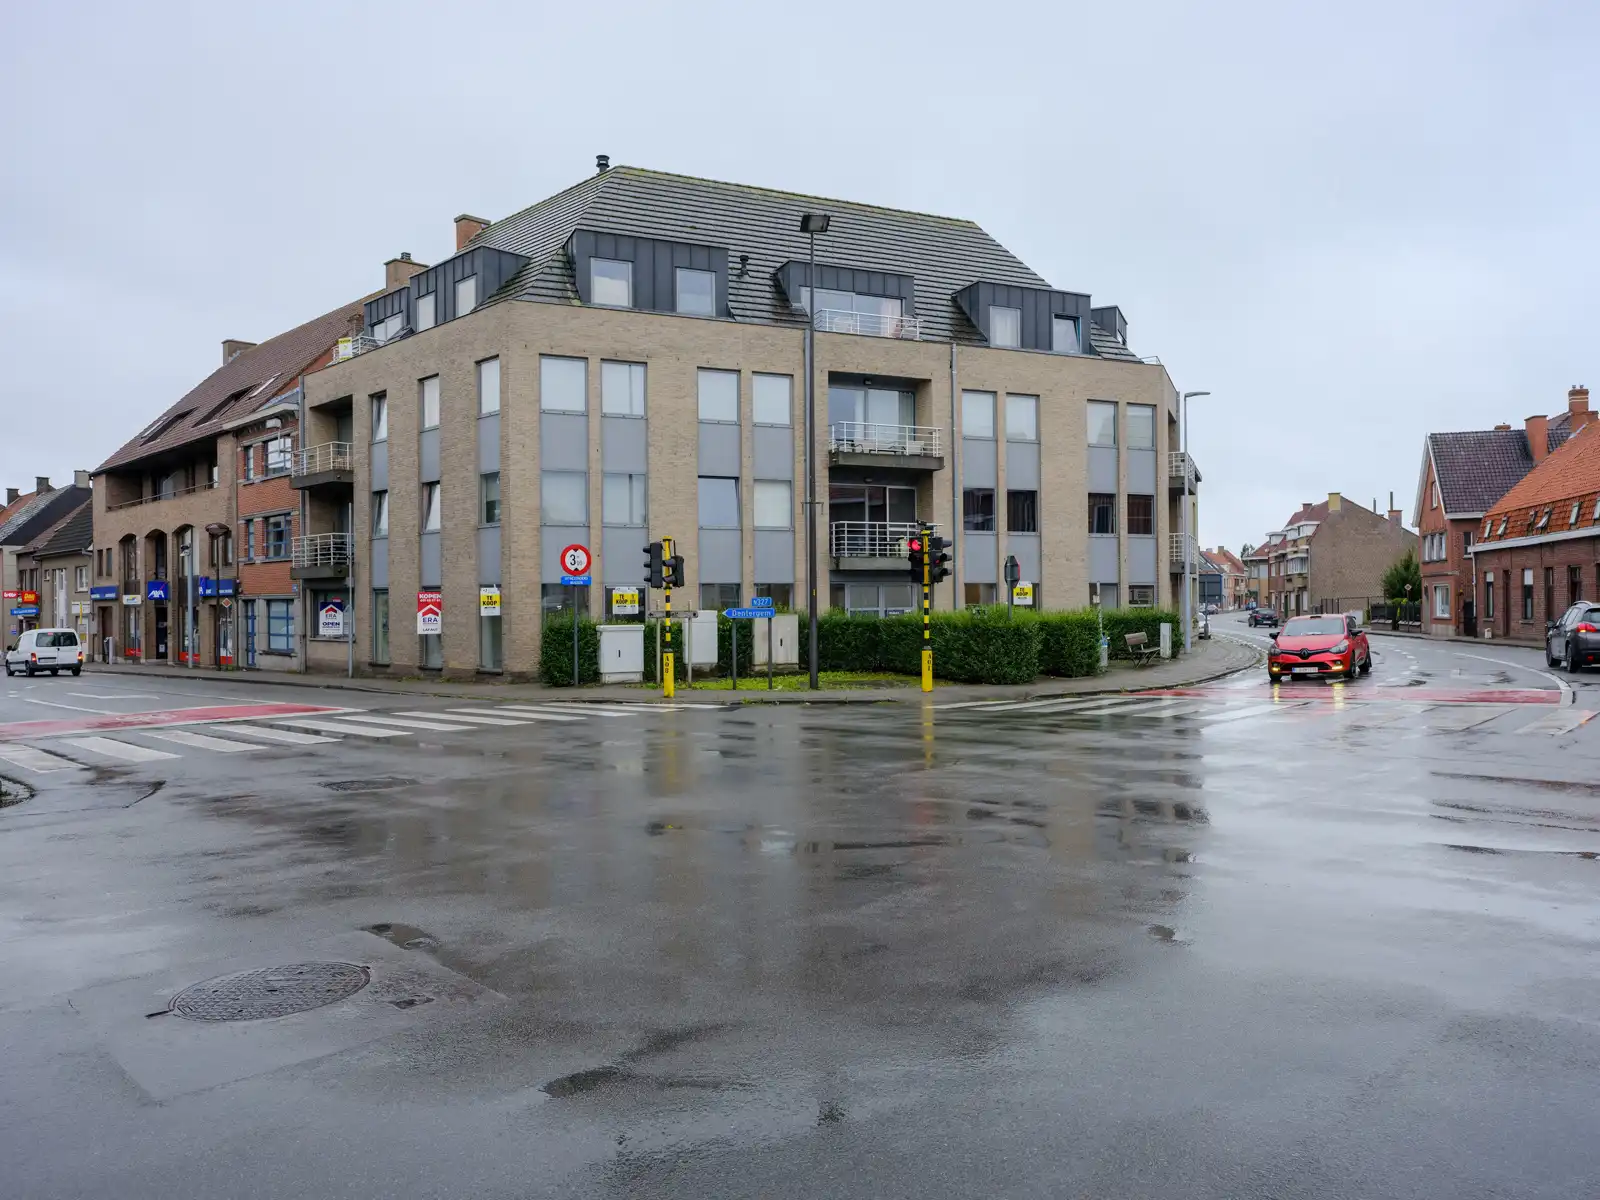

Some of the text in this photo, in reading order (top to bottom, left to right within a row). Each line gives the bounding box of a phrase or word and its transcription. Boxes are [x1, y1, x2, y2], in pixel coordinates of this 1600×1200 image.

[570, 554, 576, 566] 3
[148, 590, 165, 598] AXA
[753, 598, 769, 606] N327
[732, 610, 771, 618] Dentergem
